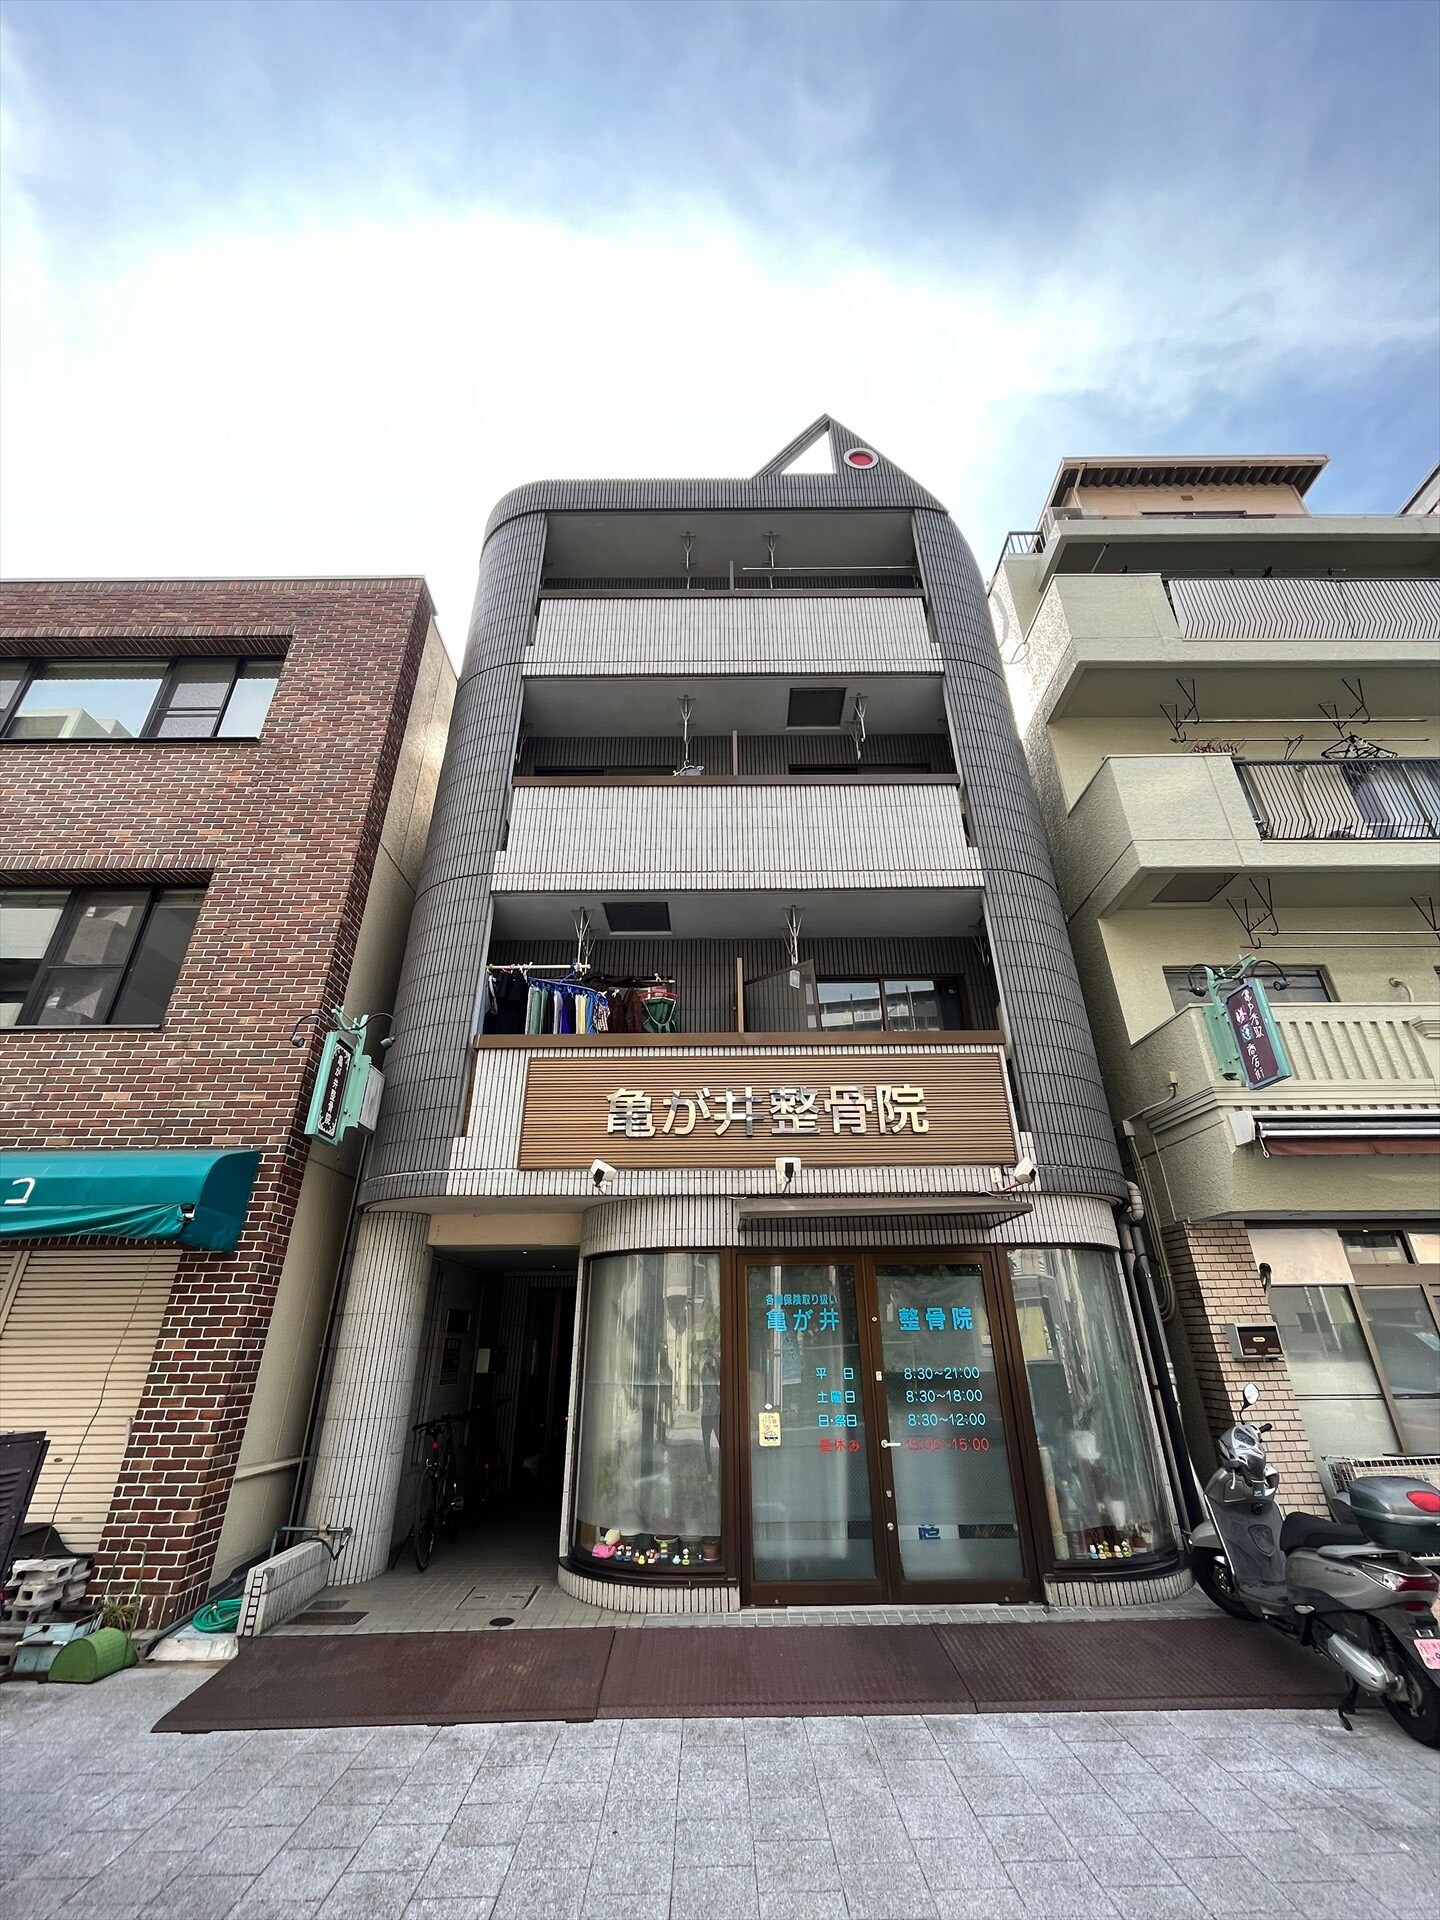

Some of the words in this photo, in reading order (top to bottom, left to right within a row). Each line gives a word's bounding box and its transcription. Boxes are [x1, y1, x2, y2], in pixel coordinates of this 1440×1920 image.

[607, 1084, 930, 1138] 亀が井整骨院
[765, 1293, 838, 1306] 各種保険取り扱い
[766, 1308, 839, 1332] 亀が井
[898, 1307, 973, 1331] 整骨院
[816, 1367, 854, 1380] 平日
[817, 1390, 856, 1404] 土曜日
